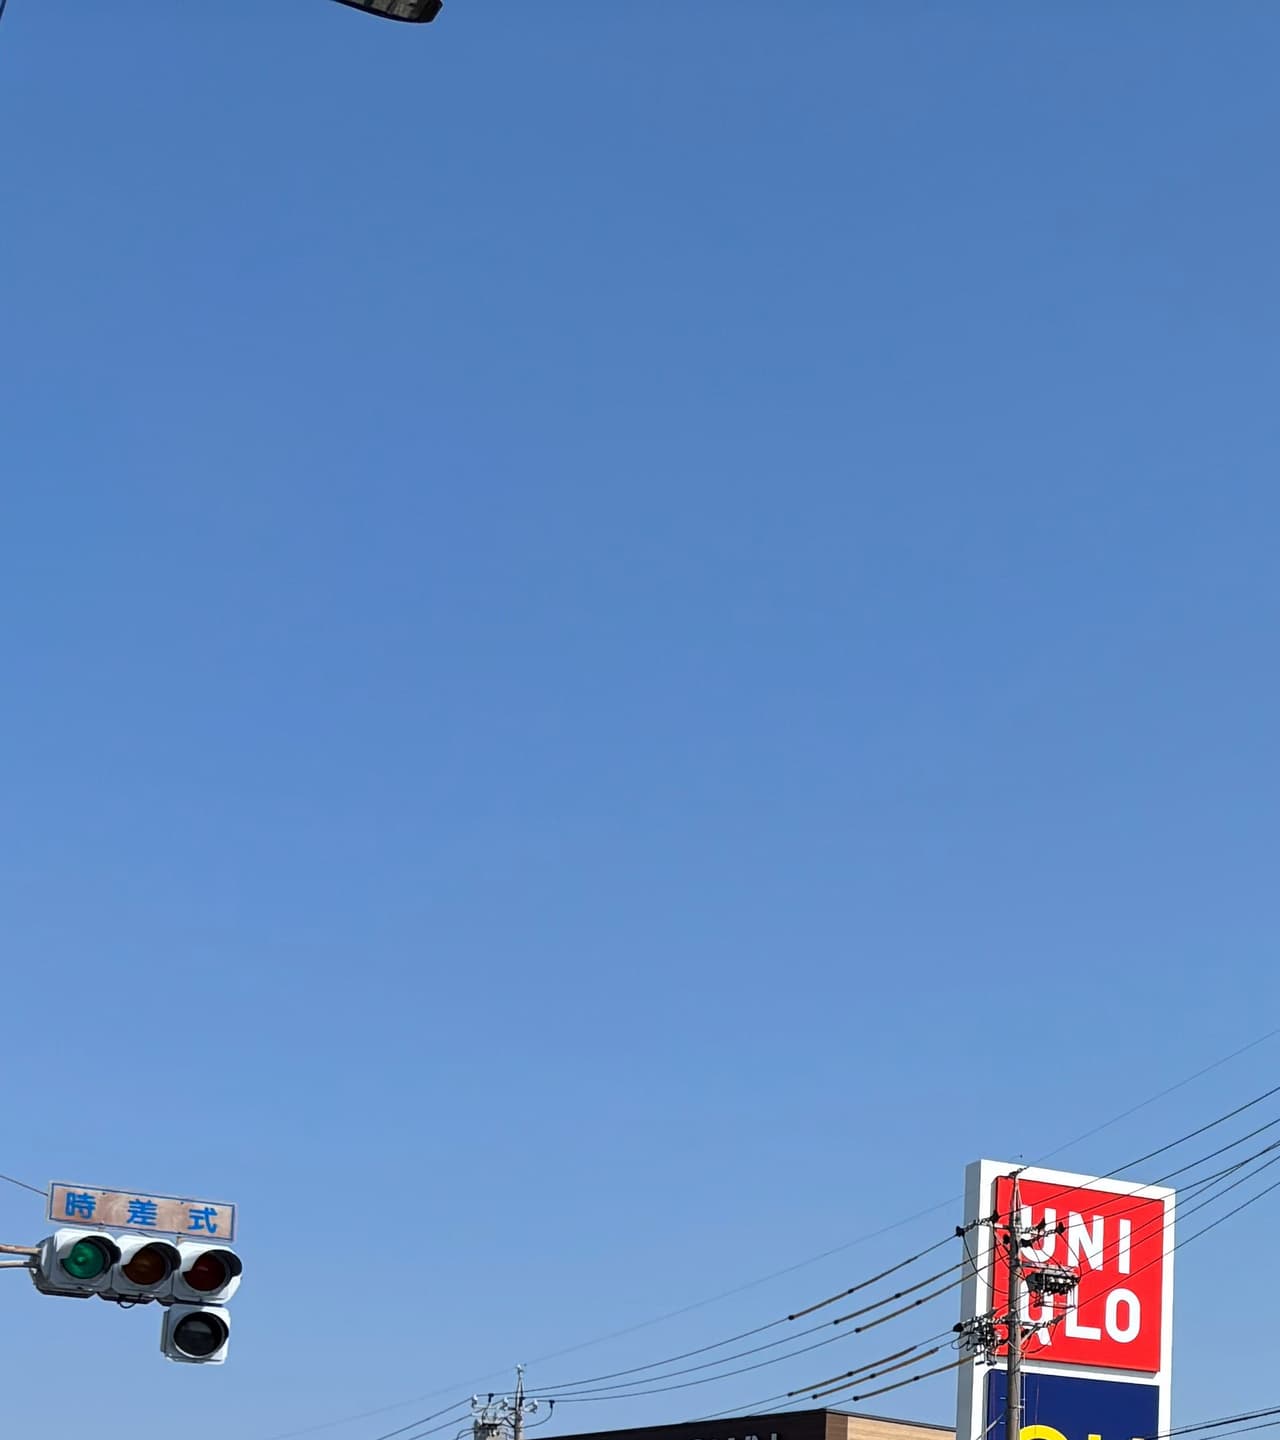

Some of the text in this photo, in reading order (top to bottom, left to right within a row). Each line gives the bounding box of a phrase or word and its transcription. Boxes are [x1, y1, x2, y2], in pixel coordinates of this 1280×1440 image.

[64, 1191, 219, 1234] 時差式
[1020, 1204, 1132, 1275] UNI
